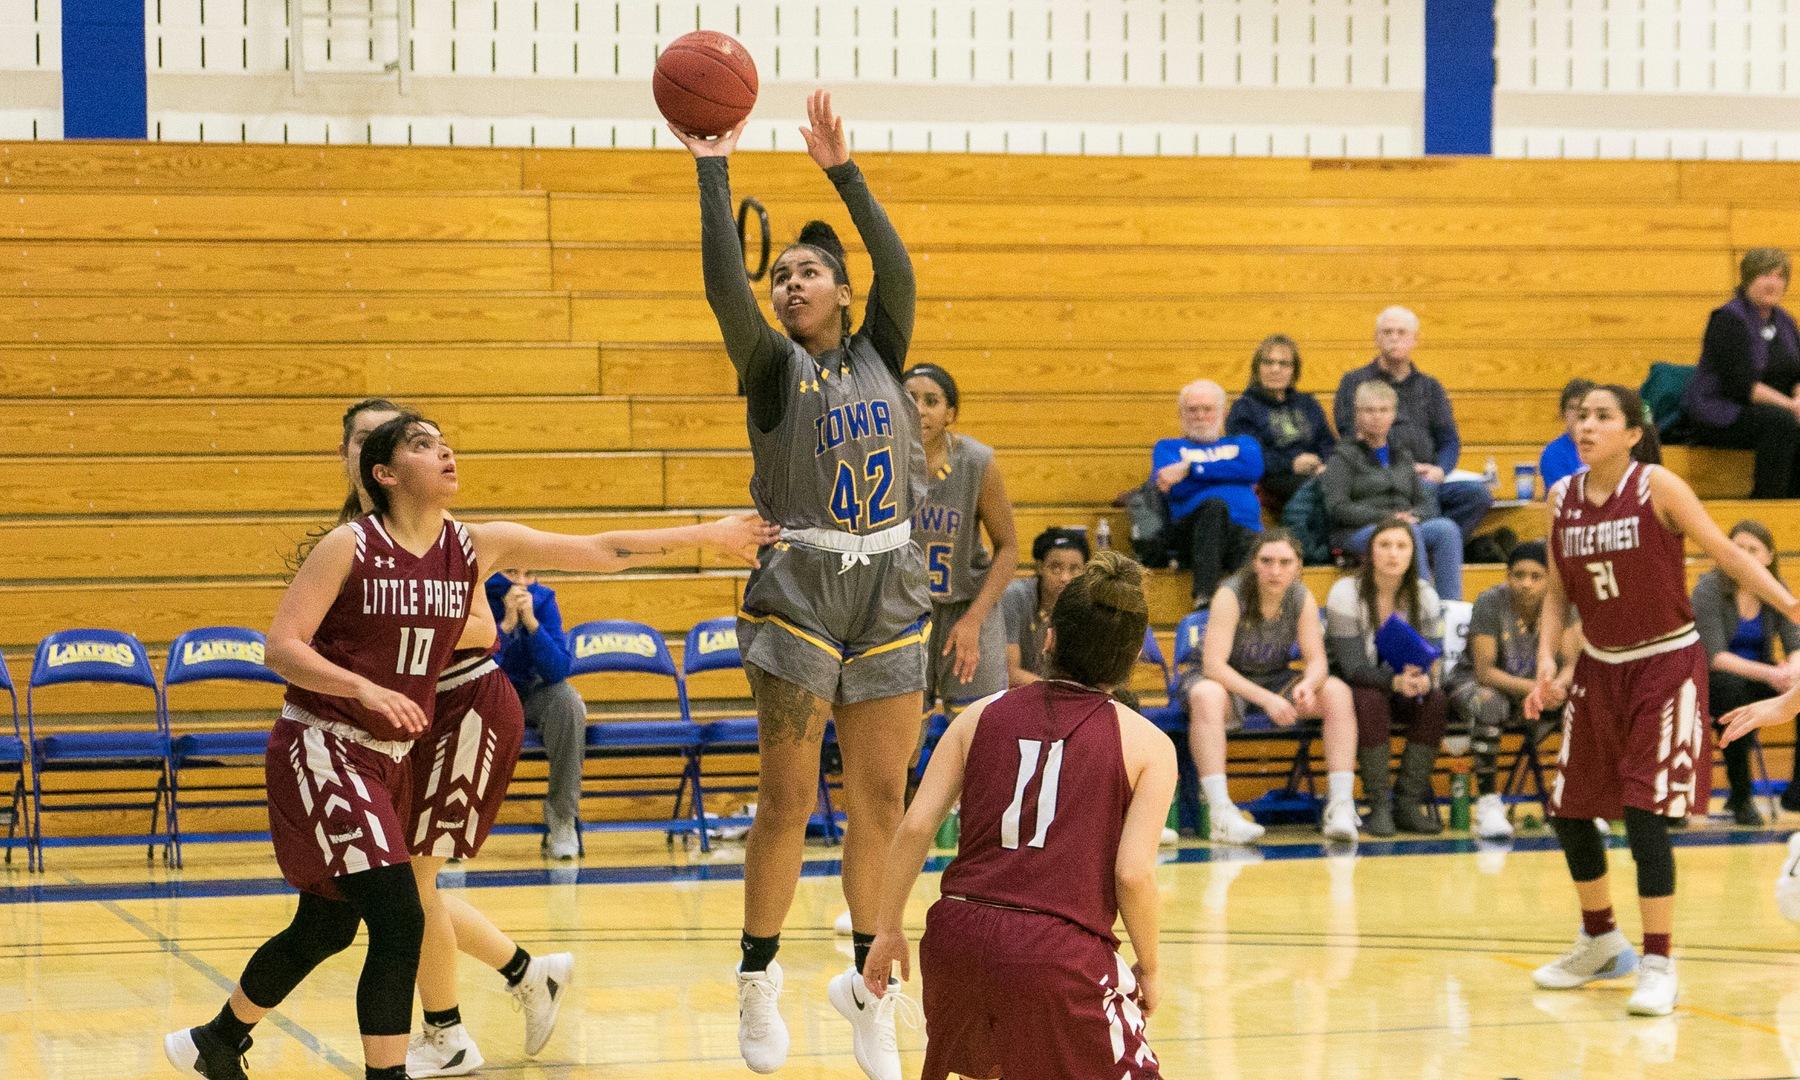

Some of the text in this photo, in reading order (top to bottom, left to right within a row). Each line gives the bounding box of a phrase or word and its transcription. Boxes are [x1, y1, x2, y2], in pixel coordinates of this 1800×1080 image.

[814, 400, 893, 458] IOWA
[829, 446, 898, 533] 42
[911, 506, 963, 535] WA
[1597, 516, 1640, 553] PRIEST
[363, 579, 469, 618] LITTLE PRIEST
[1585, 560, 1620, 600] 21
[47, 641, 136, 667] LAKERS
[183, 640, 265, 666] LAKERS
[396, 627, 435, 676] 10
[575, 632, 657, 659] LAKERS
[1001, 739, 1064, 849] 11
